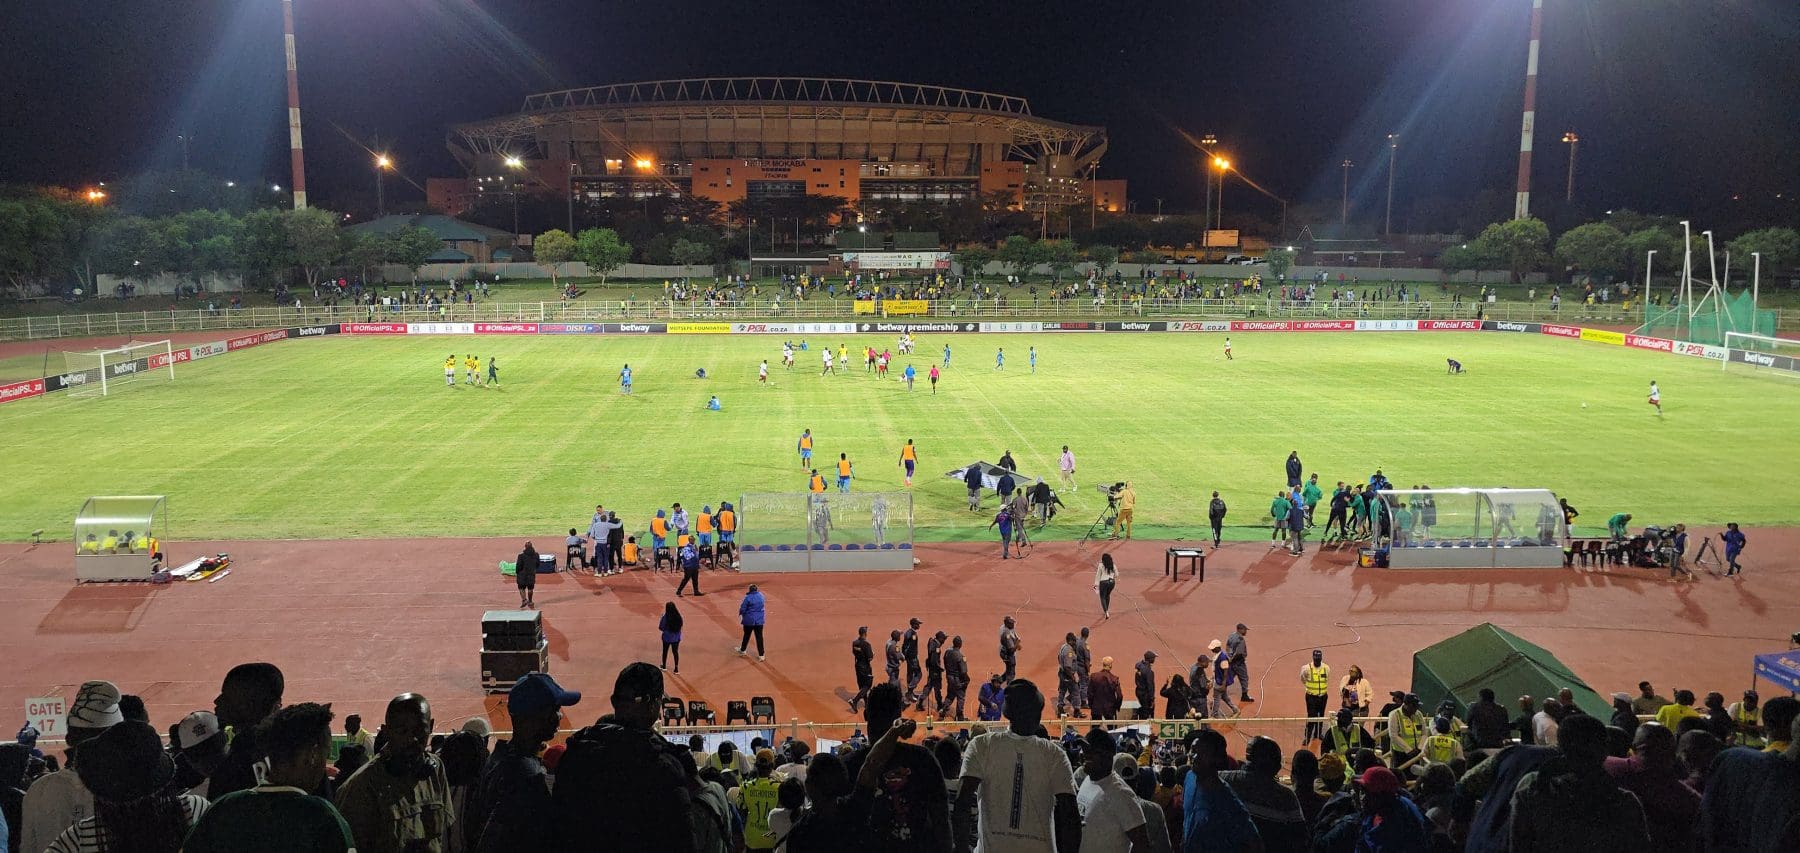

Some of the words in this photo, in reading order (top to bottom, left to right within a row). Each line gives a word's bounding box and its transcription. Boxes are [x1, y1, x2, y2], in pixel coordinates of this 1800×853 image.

[620, 324, 650, 333] betway
[877, 323, 906, 333] betway
[907, 323, 959, 332] premiership
[1121, 322, 1150, 331] betway
[1182, 322, 1204, 331] PSL
[1433, 321, 1459, 329] Official
[1460, 321, 1476, 329] PSL
[1497, 321, 1527, 333] betway
[300, 327, 326, 336] betway
[1633, 337, 1671, 351] @OfficialPSL
[1686, 344, 1704, 356] PSL
[177, 351, 188, 361] PSL
[1745, 351, 1775, 367] betway
[60, 373, 86, 386] betway
[29, 703, 62, 715] GATE
[38, 719, 55, 731] 17
